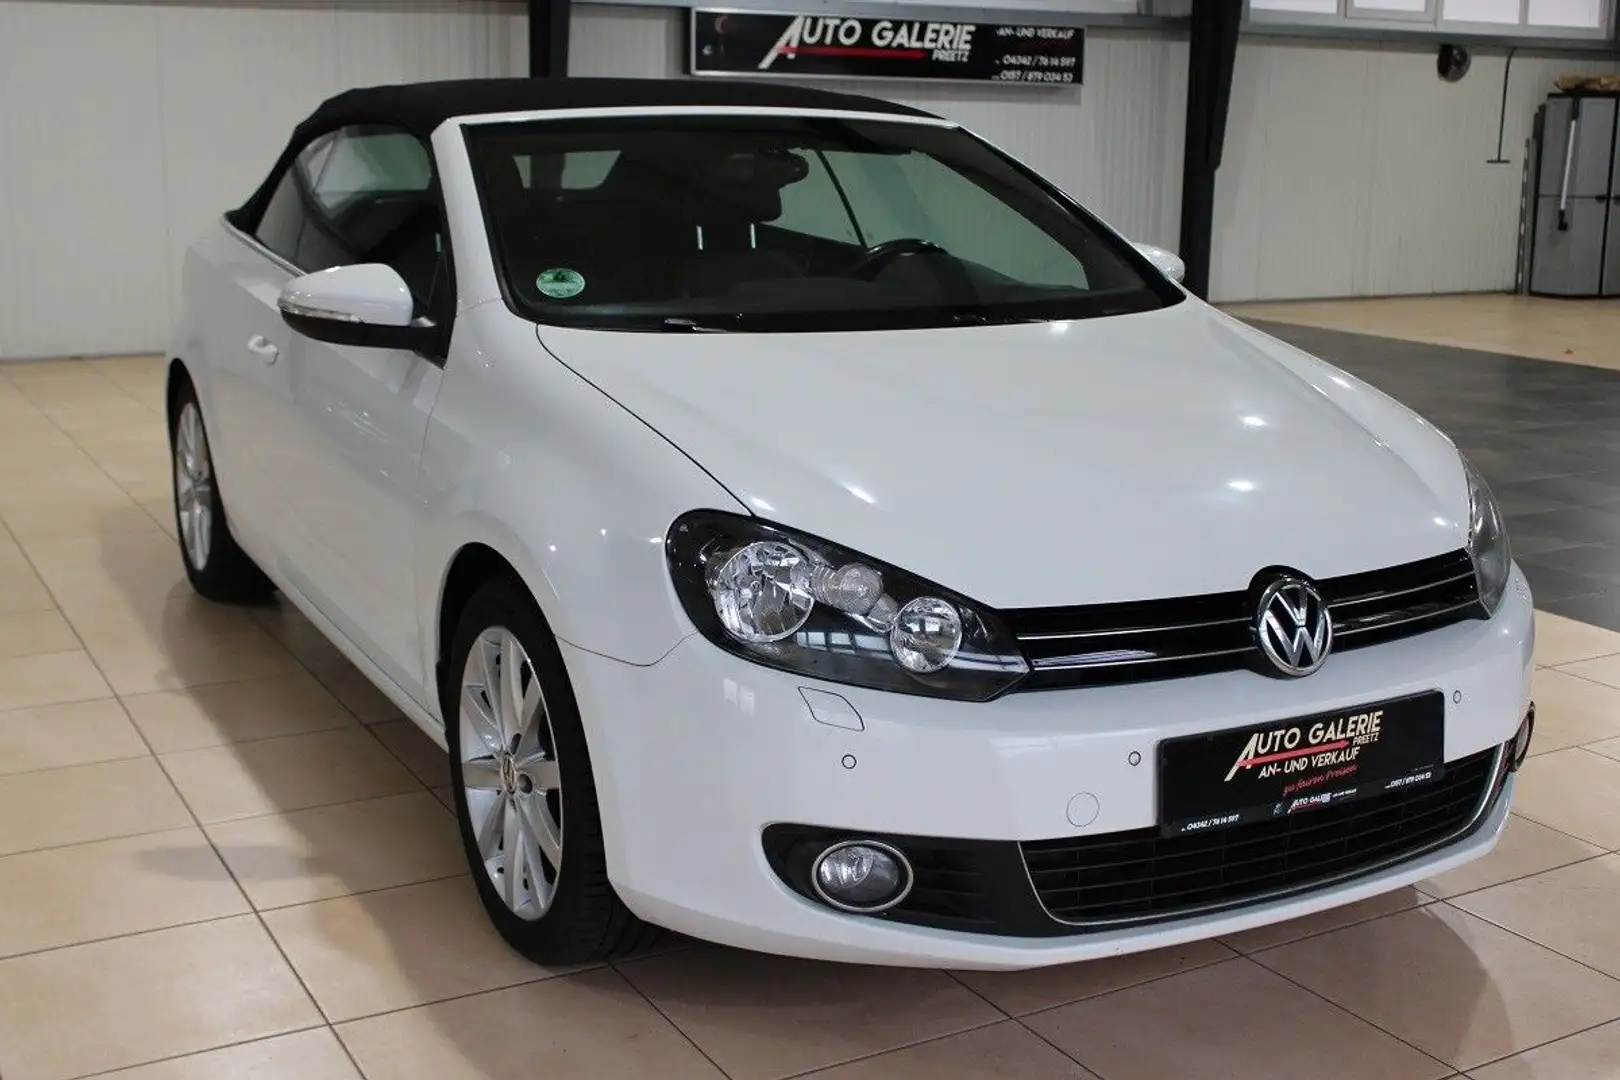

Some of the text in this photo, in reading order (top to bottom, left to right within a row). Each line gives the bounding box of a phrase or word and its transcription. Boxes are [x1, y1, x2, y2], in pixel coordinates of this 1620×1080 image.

[758, 15, 976, 69] AUTO GALERIE
[932, 49, 970, 62] PREETZ
[1223, 710, 1384, 782] AUTO GALERIE
[1352, 732, 1379, 747] PREETZ
[1258, 746, 1360, 779] AN- UND VERKAUF
